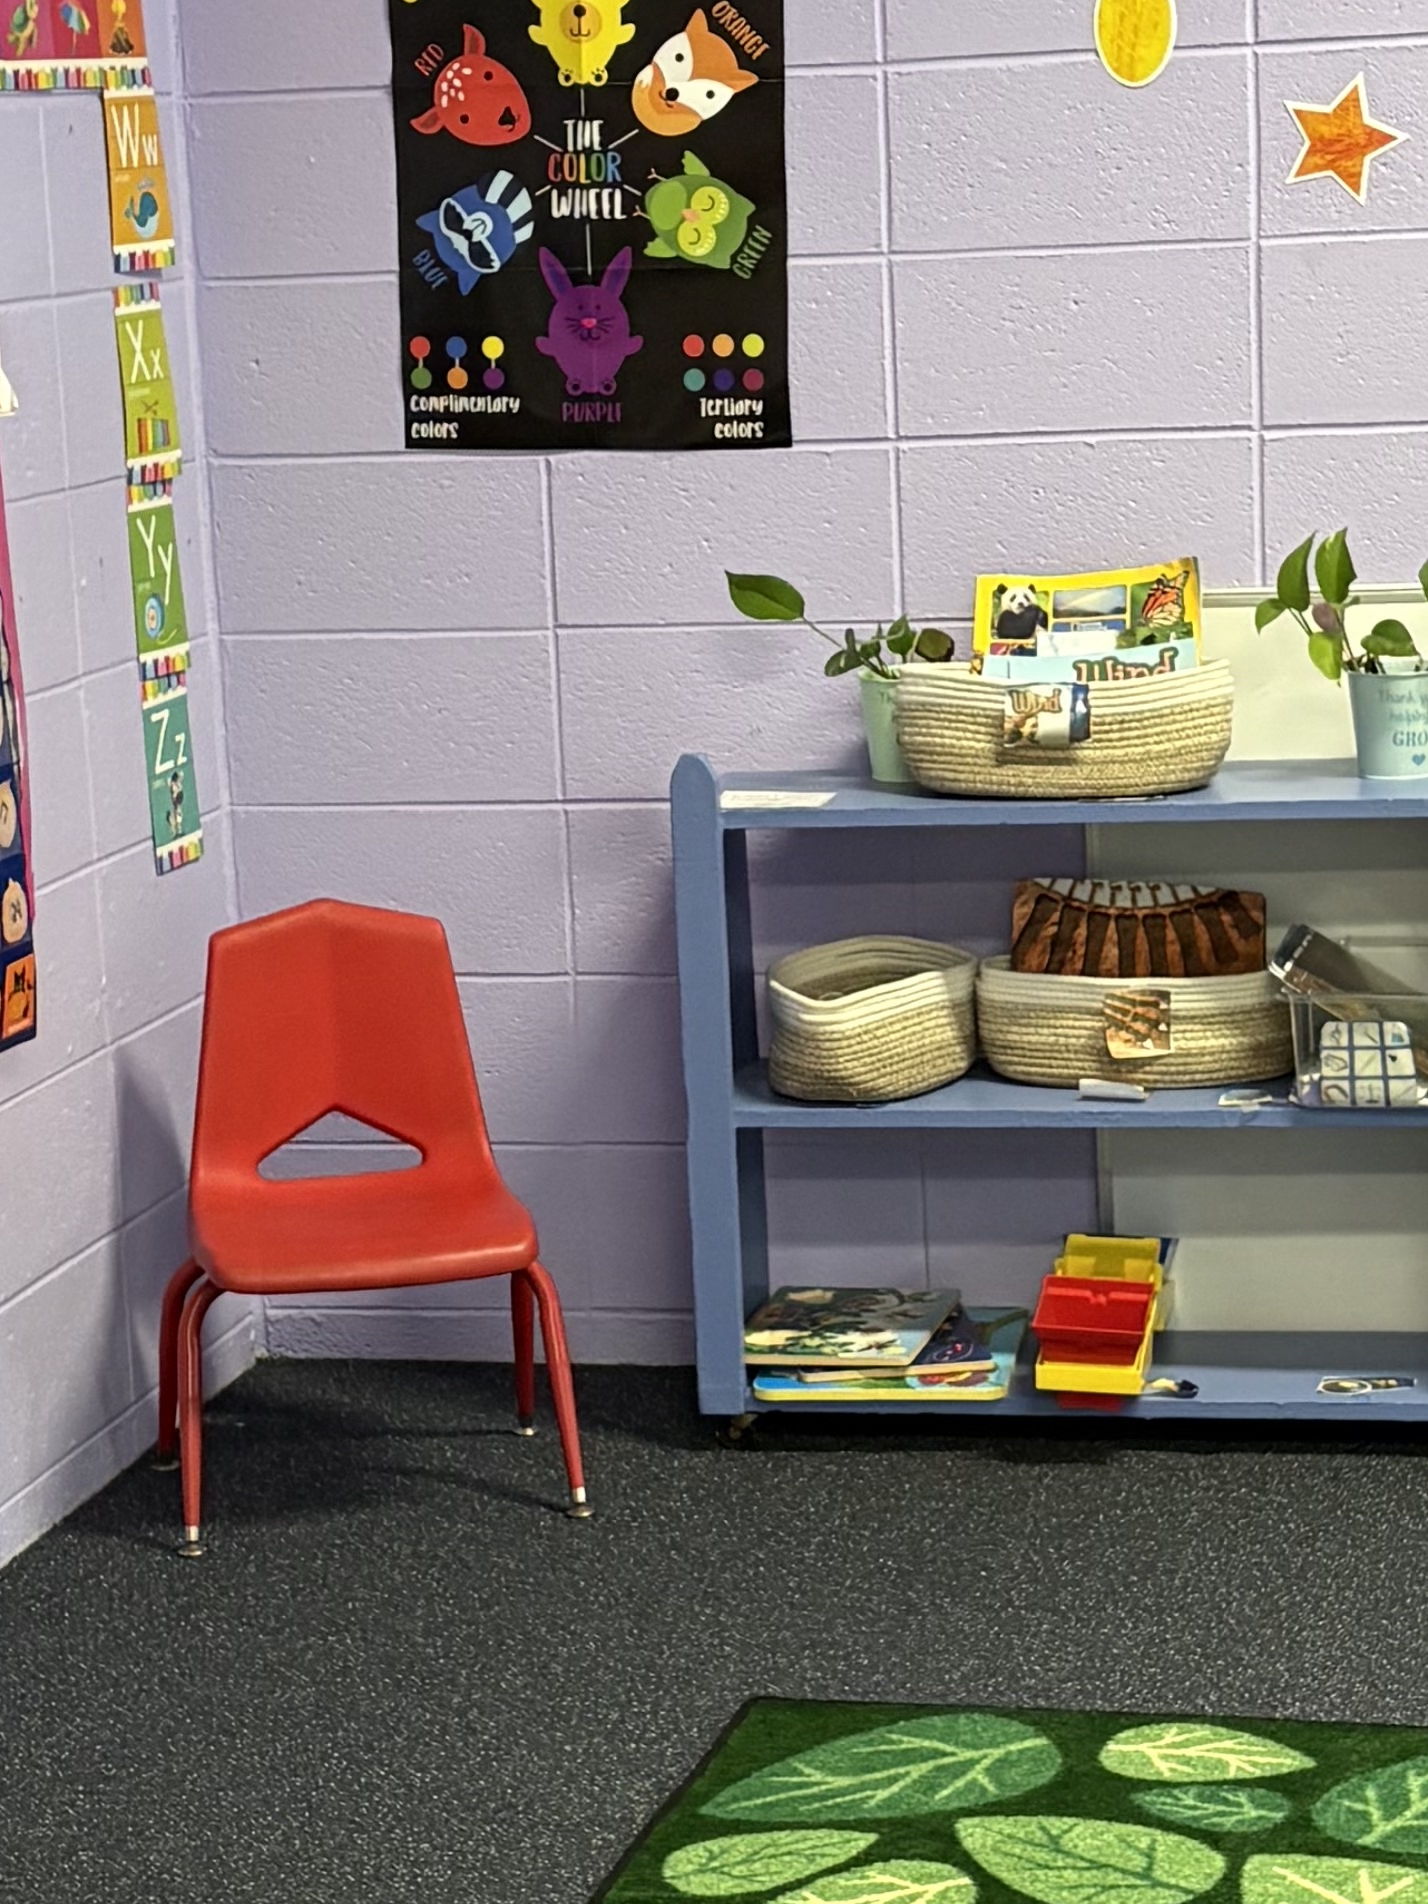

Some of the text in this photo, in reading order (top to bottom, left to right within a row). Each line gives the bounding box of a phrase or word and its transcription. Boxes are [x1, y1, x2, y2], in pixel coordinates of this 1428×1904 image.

[711, 0, 772, 62] ORANGE
[413, 42, 446, 78] RED
[110, 101, 159, 170] Ww
[563, 119, 605, 152] THE
[547, 152, 622, 184] COLOR
[550, 187, 628, 221] WHEEL
[411, 247, 449, 291] BLUE
[732, 224, 774, 281] GREEN
[124, 318, 165, 385] Xx
[410, 419, 459, 440] colors
[561, 401, 622, 424] PURPLE
[713, 421, 765, 440] colors
[135, 514, 174, 607] Yy
[149, 708, 188, 775] Zz
